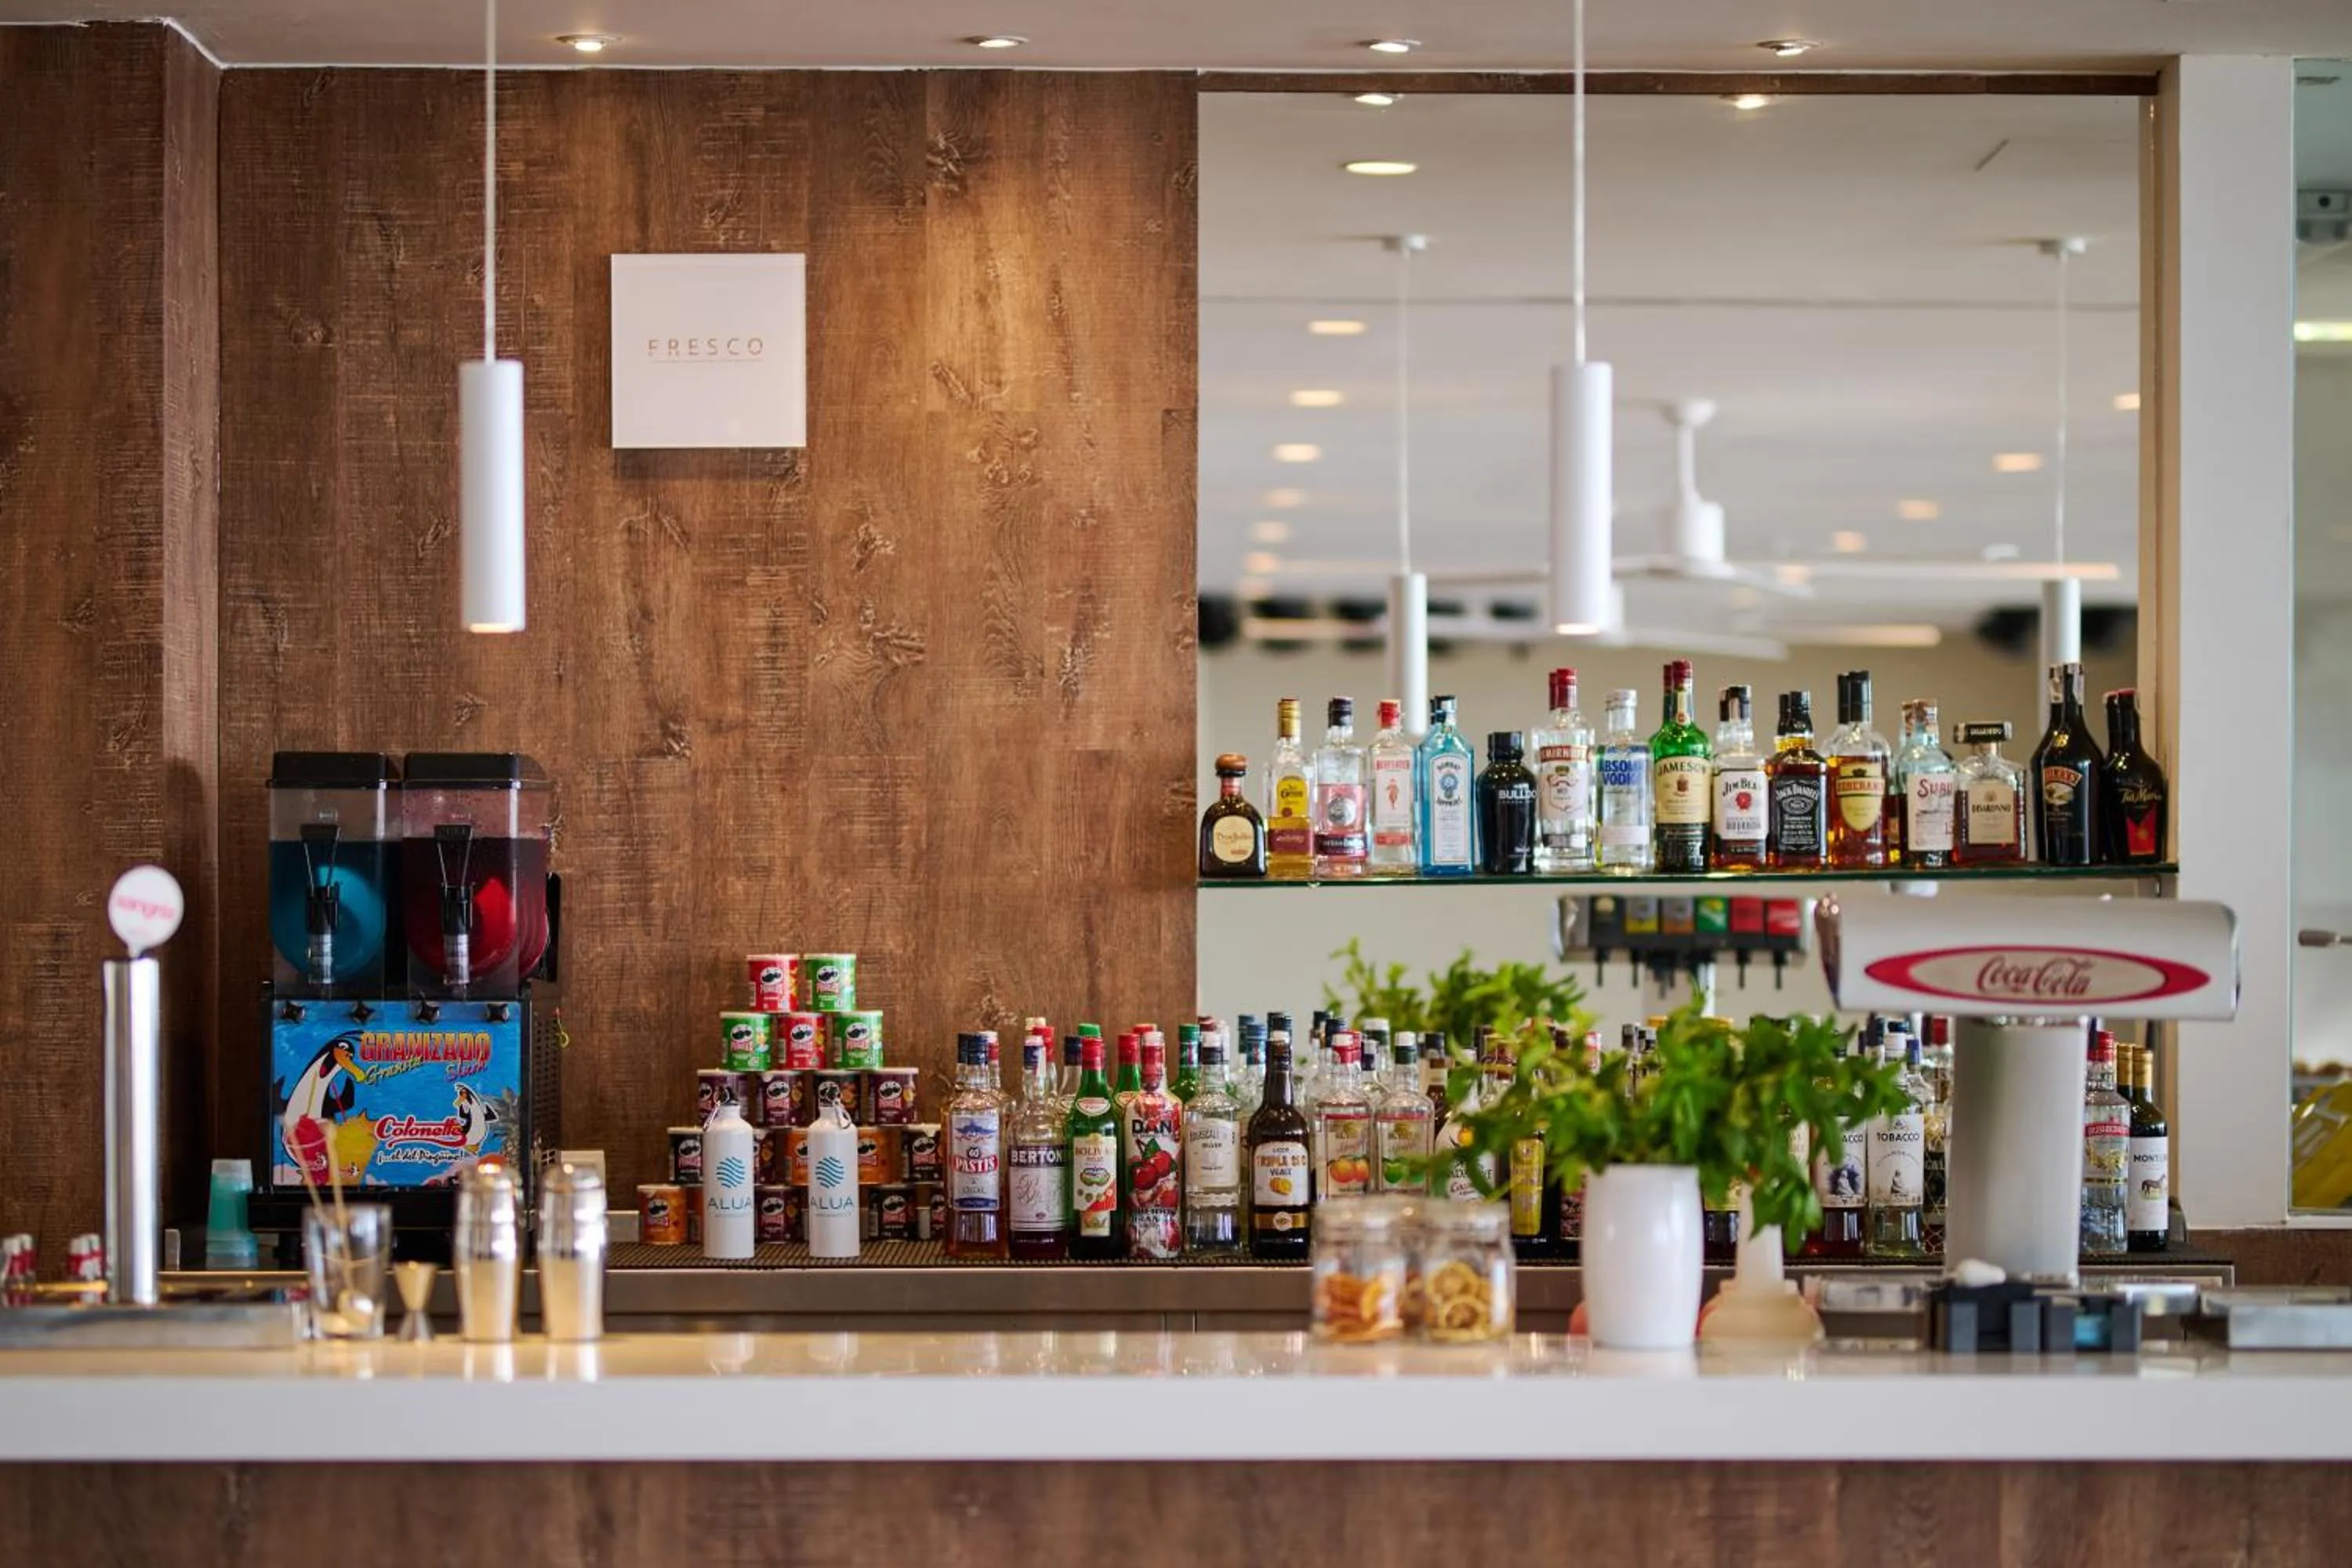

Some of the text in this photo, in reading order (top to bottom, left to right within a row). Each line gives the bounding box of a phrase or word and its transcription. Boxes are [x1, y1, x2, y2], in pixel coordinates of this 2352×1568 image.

[648, 337, 764, 357] FRESCO
[1976, 955, 2096, 996] Coca-Cola
[360, 1031, 492, 1062] GRANIZADO
[1876, 1132, 1920, 1142] TOBACCO
[955, 1156, 996, 1172] PASTIS
[708, 1196, 752, 1210] ALUA
[810, 1196, 854, 1210] ALUA
